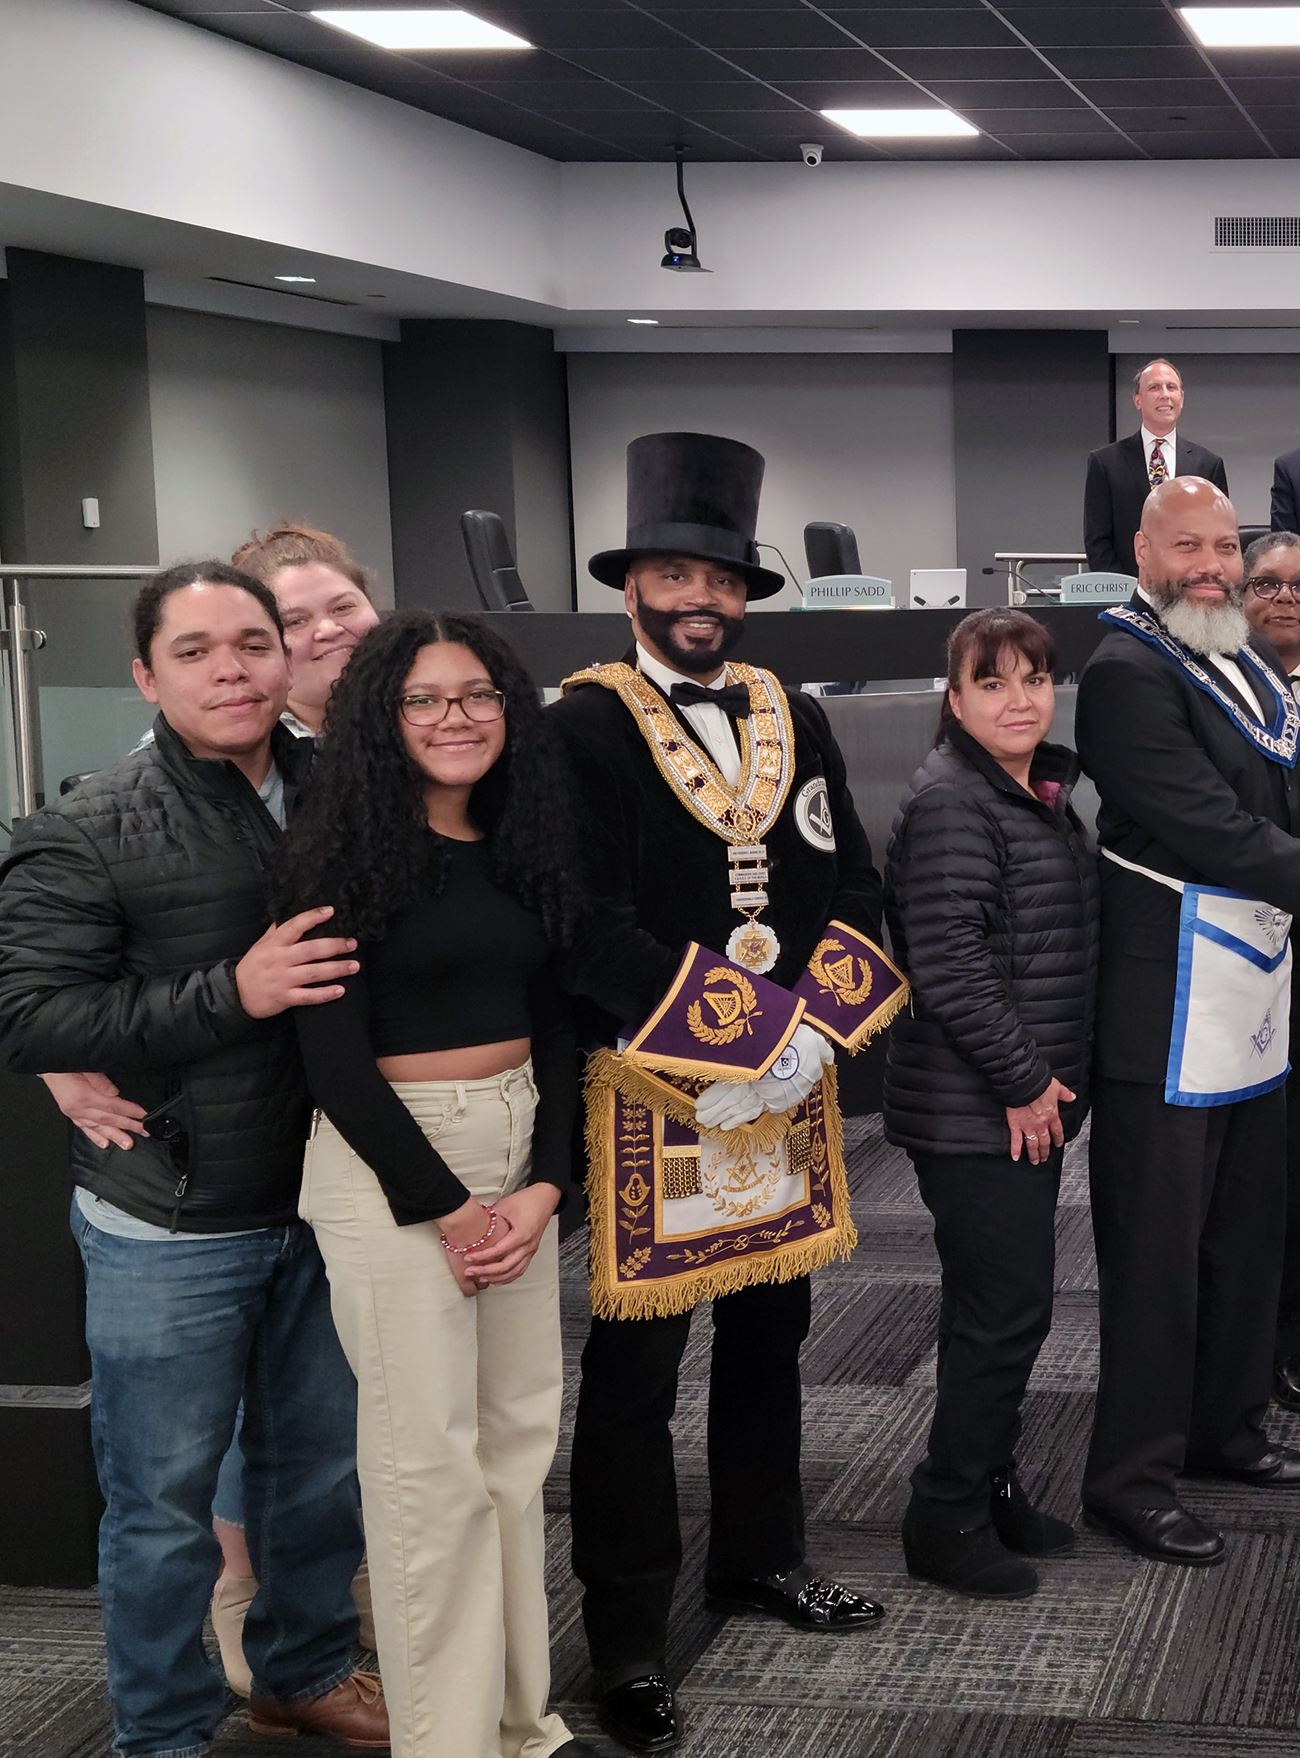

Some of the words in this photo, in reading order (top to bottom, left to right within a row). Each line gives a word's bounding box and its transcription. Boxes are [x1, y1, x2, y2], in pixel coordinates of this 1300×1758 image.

[810, 586, 851, 597] PHILLIP
[853, 586, 885, 597] SADD
[1070, 583, 1092, 593] ERIC
[1094, 583, 1129, 593] CHRIST
